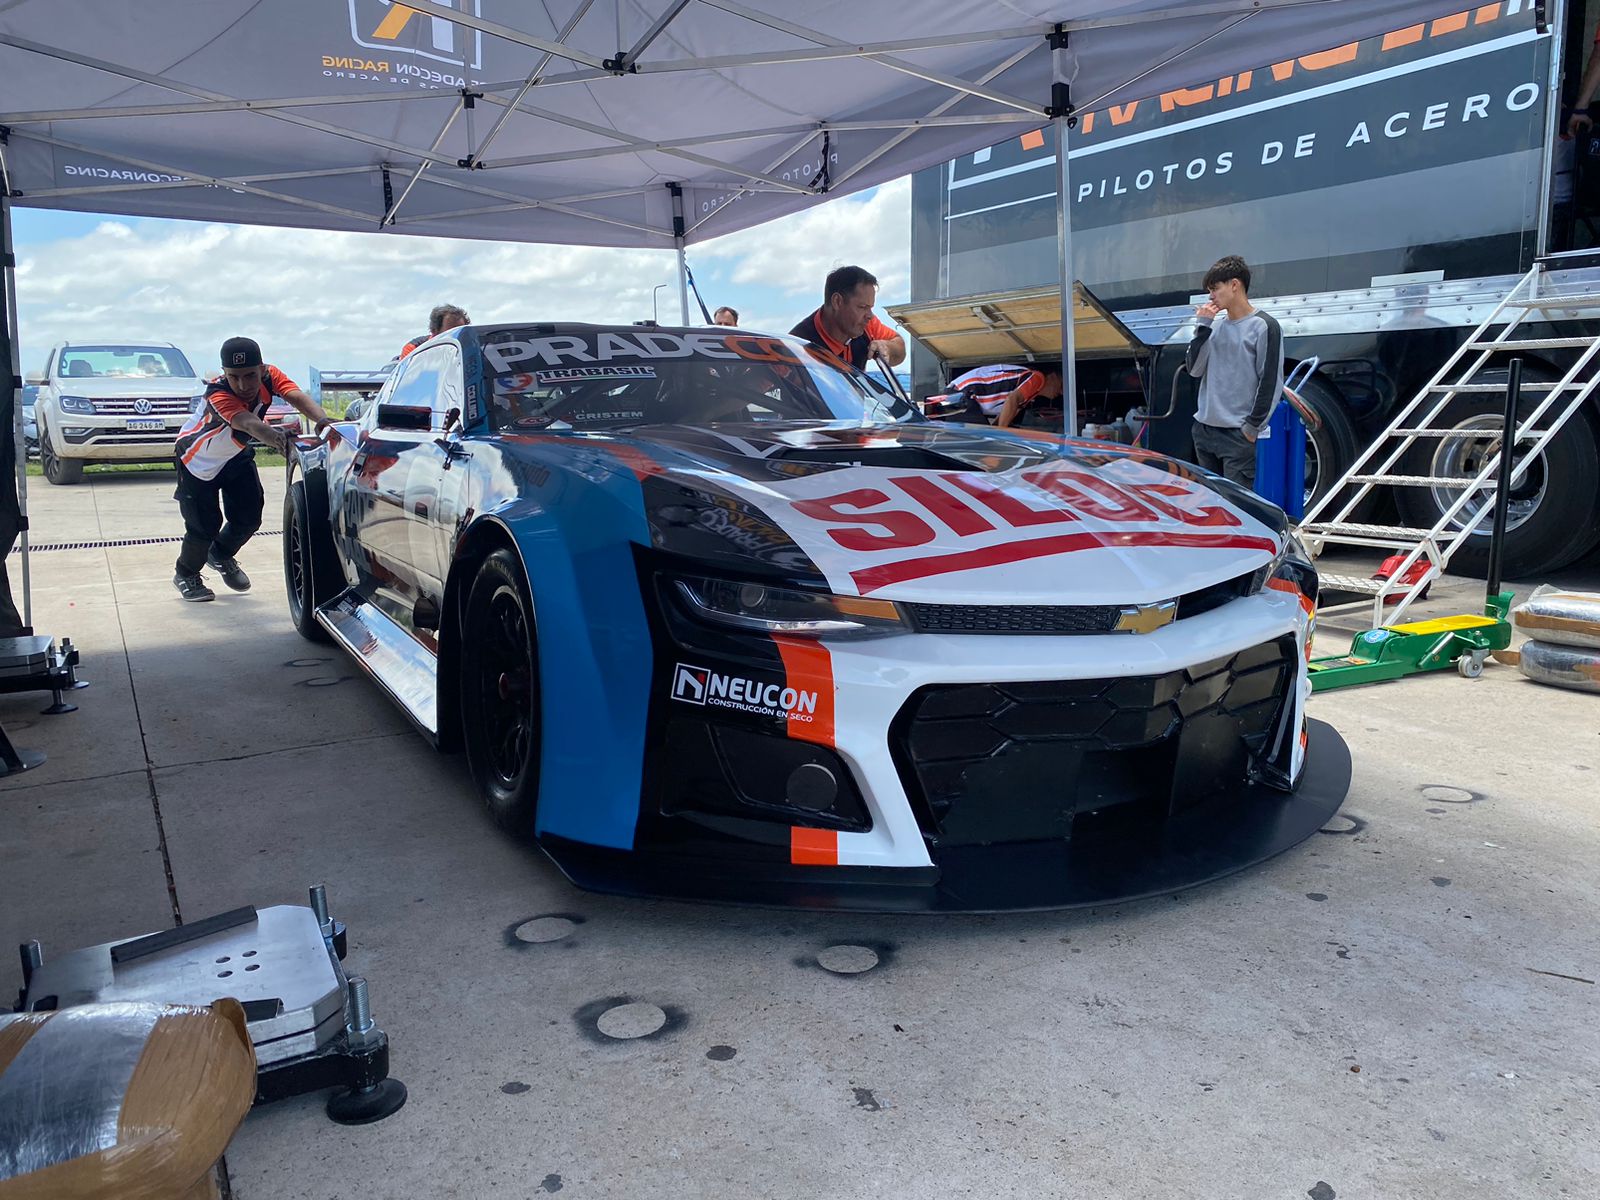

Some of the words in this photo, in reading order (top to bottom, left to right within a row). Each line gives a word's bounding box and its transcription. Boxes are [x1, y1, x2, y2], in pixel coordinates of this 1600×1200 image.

[1077, 151, 1233, 203] PILOTOS
[1260, 133, 1317, 166] DE
[1345, 81, 1540, 149] ACERO
[538, 366, 655, 380] TRABASIL
[575, 411, 643, 420] CRISTEM
[709, 673, 818, 714] NEUCON
[707, 697, 775, 716] CONSTRUCCIÓN
[776, 710, 789, 719] EN
[790, 712, 813, 723] SECO
